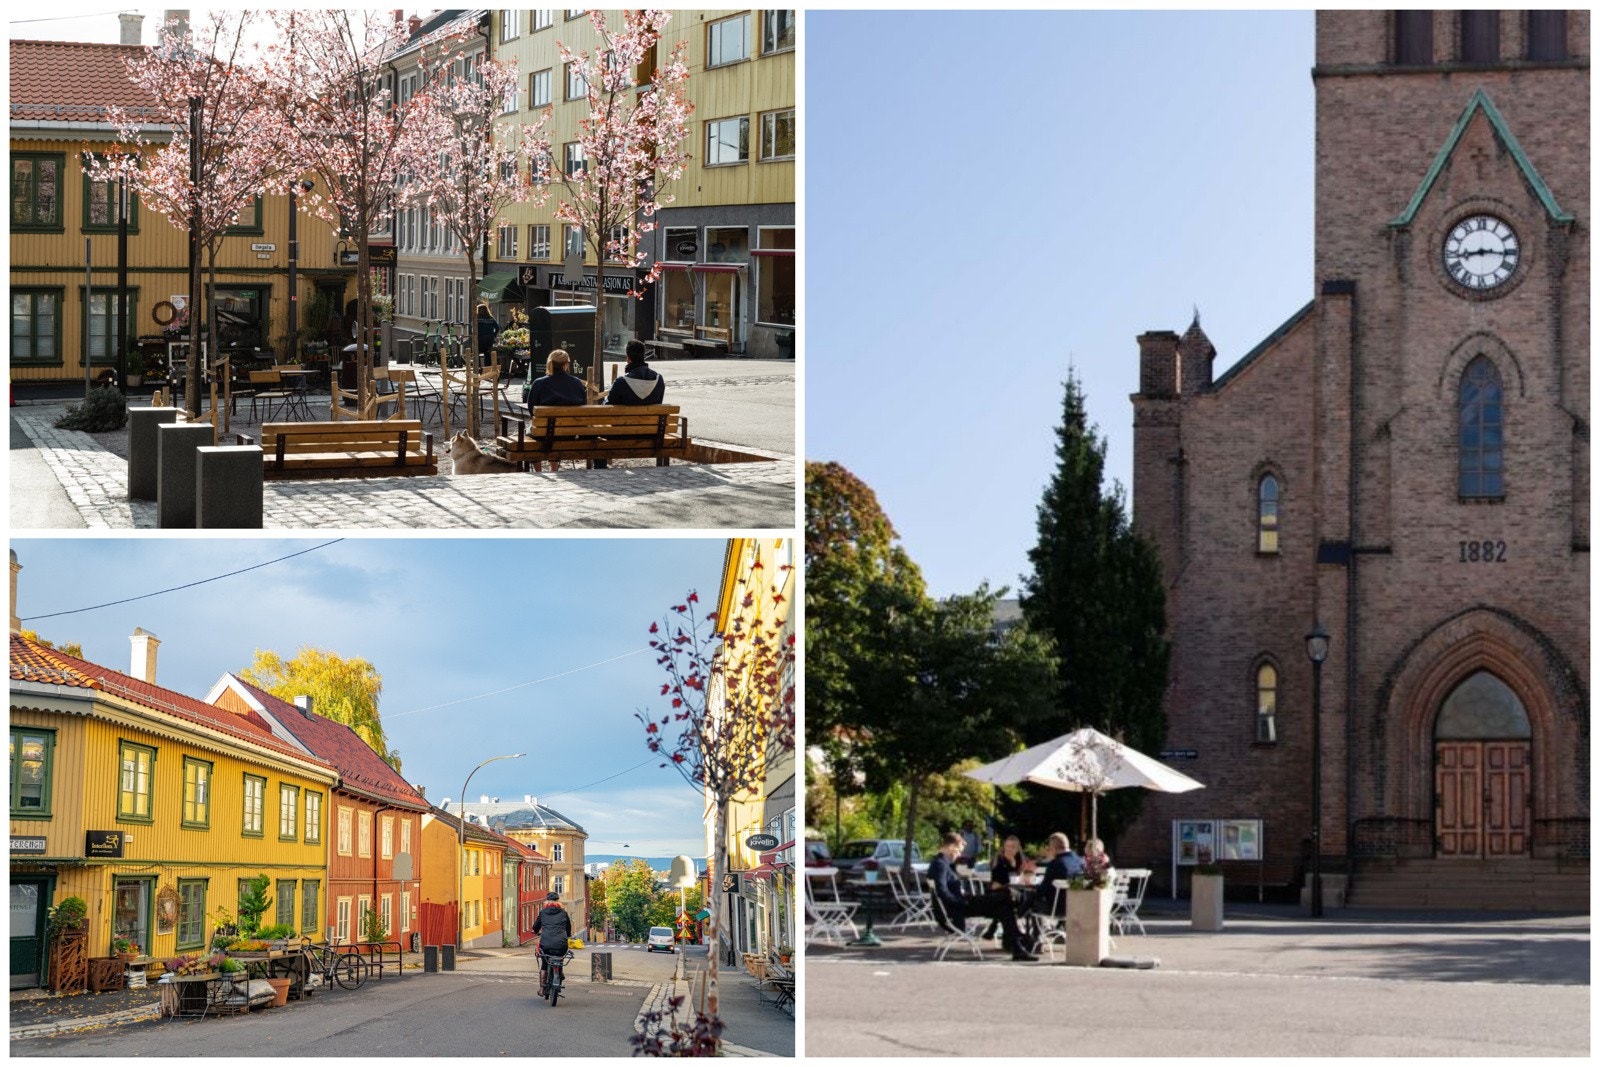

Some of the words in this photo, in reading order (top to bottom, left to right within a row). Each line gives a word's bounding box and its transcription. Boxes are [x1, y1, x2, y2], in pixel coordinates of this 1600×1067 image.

[580, 277, 622, 290] INSTAASJON
[622, 278, 631, 290] AS
[1459, 540, 1507, 563] 1882
